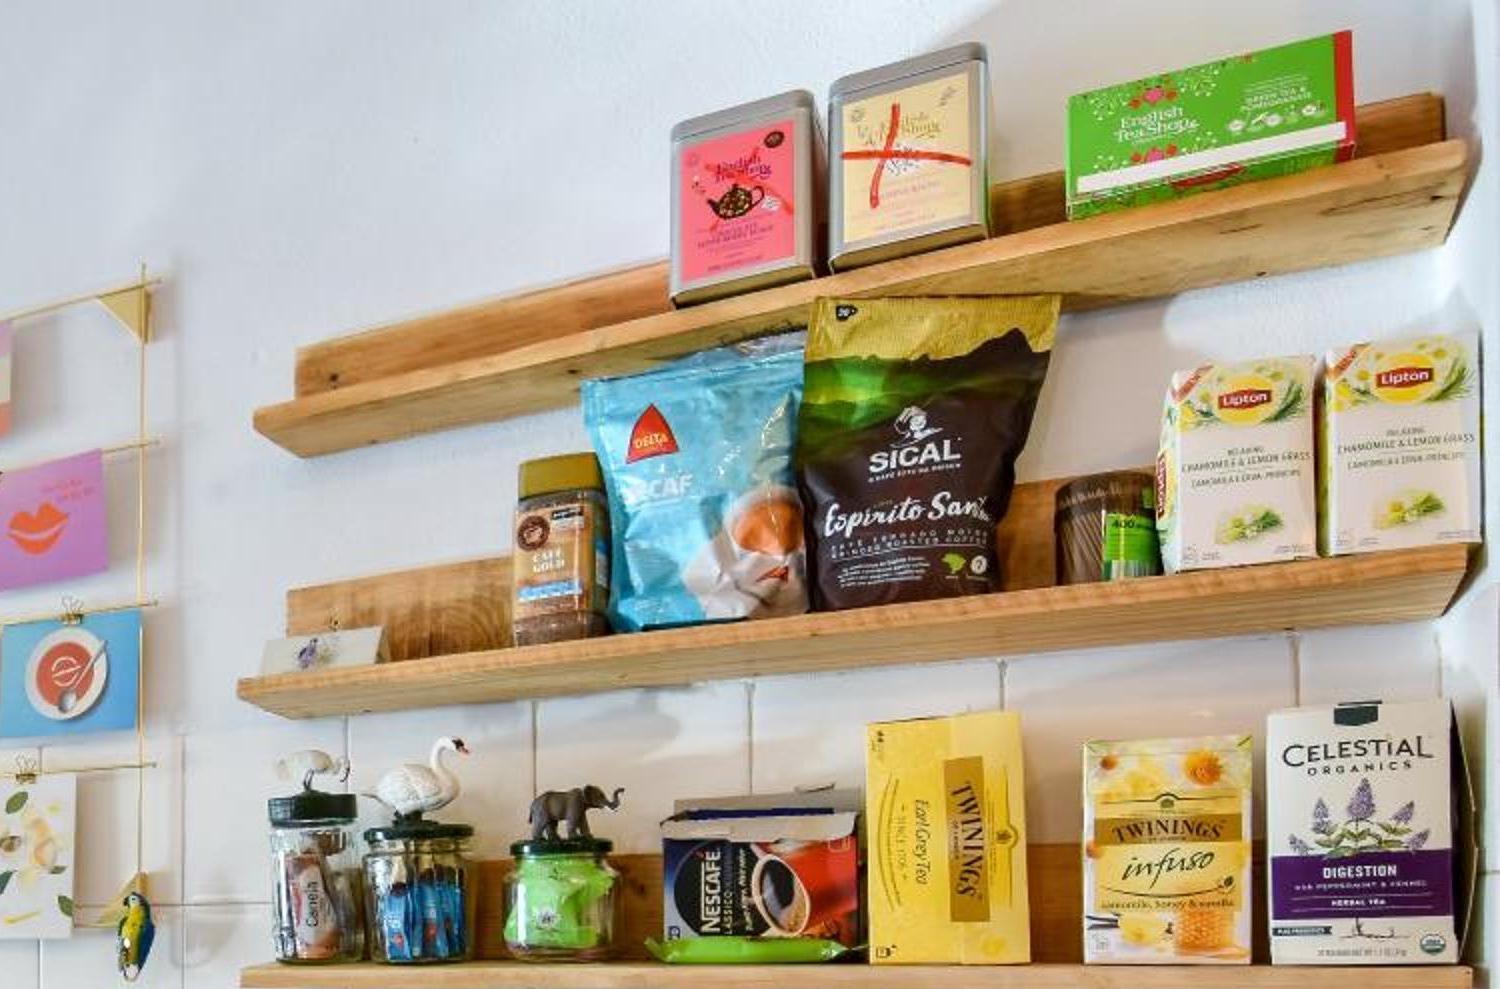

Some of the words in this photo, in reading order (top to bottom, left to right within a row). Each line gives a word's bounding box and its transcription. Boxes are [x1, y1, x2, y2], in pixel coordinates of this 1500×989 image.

[1381, 370, 1430, 386] Lipton
[1222, 391, 1268, 407] Lipton
[635, 432, 669, 449] DELTA
[869, 439, 962, 473] SICAL
[1307, 759, 1412, 777] ORGANICS
[950, 784, 985, 897] TWININGS
[1112, 819, 1222, 842] TWININGS
[913, 829, 930, 862] Grey
[916, 862, 931, 885] Tea
[1121, 847, 1215, 890] infuso
[1323, 864, 1398, 880] DIGESTION
[306, 881, 319, 927] Canela
